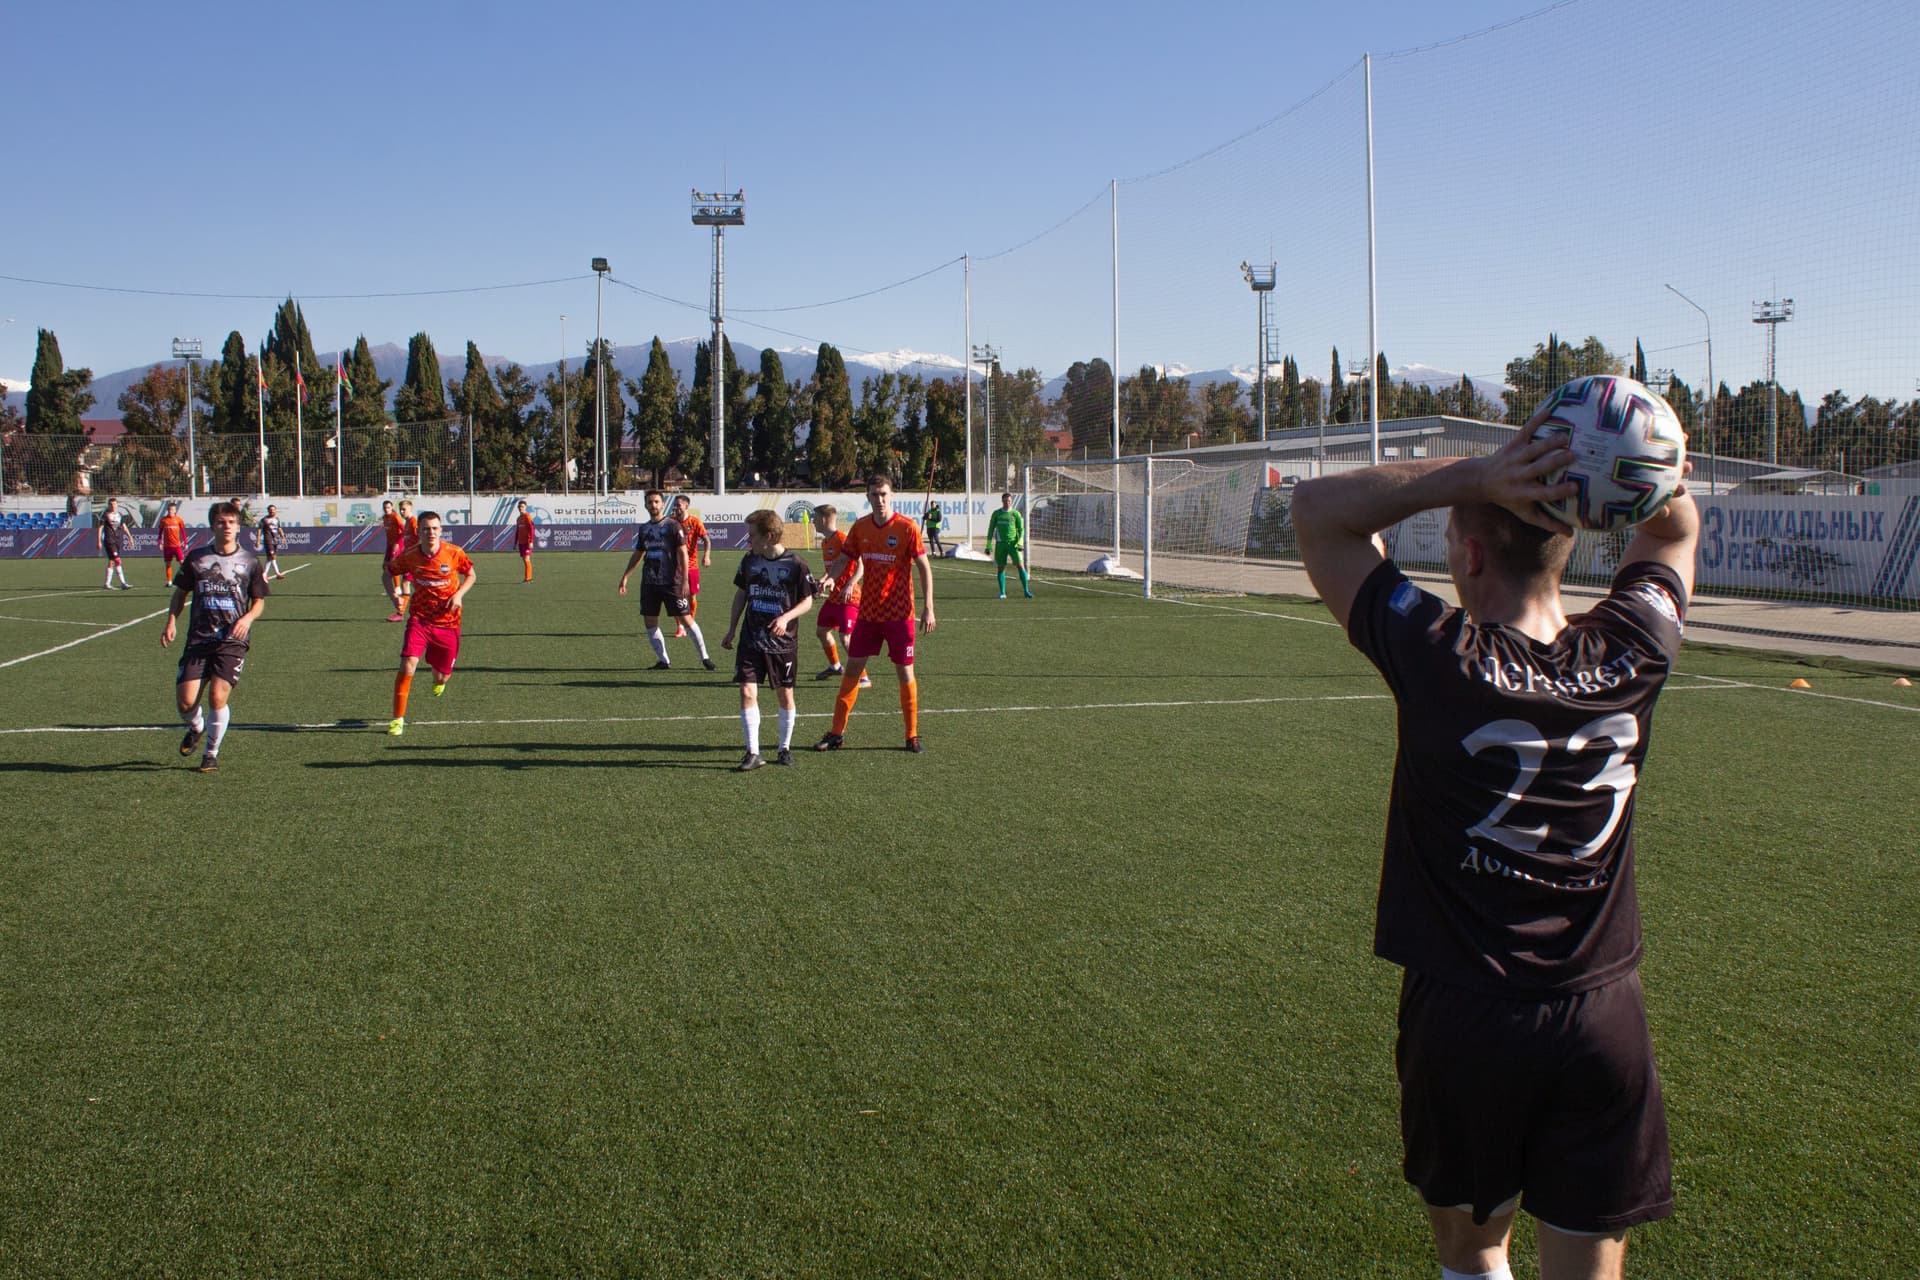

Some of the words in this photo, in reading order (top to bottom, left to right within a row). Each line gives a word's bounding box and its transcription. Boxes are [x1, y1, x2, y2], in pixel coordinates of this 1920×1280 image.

[554, 506, 637, 515] ФУТБОЛЬНЫЙ
[1702, 506, 1724, 569] 3
[1729, 509, 1885, 542] УНИКАЛЬНЫХ
[1460, 711, 1639, 861] 23
